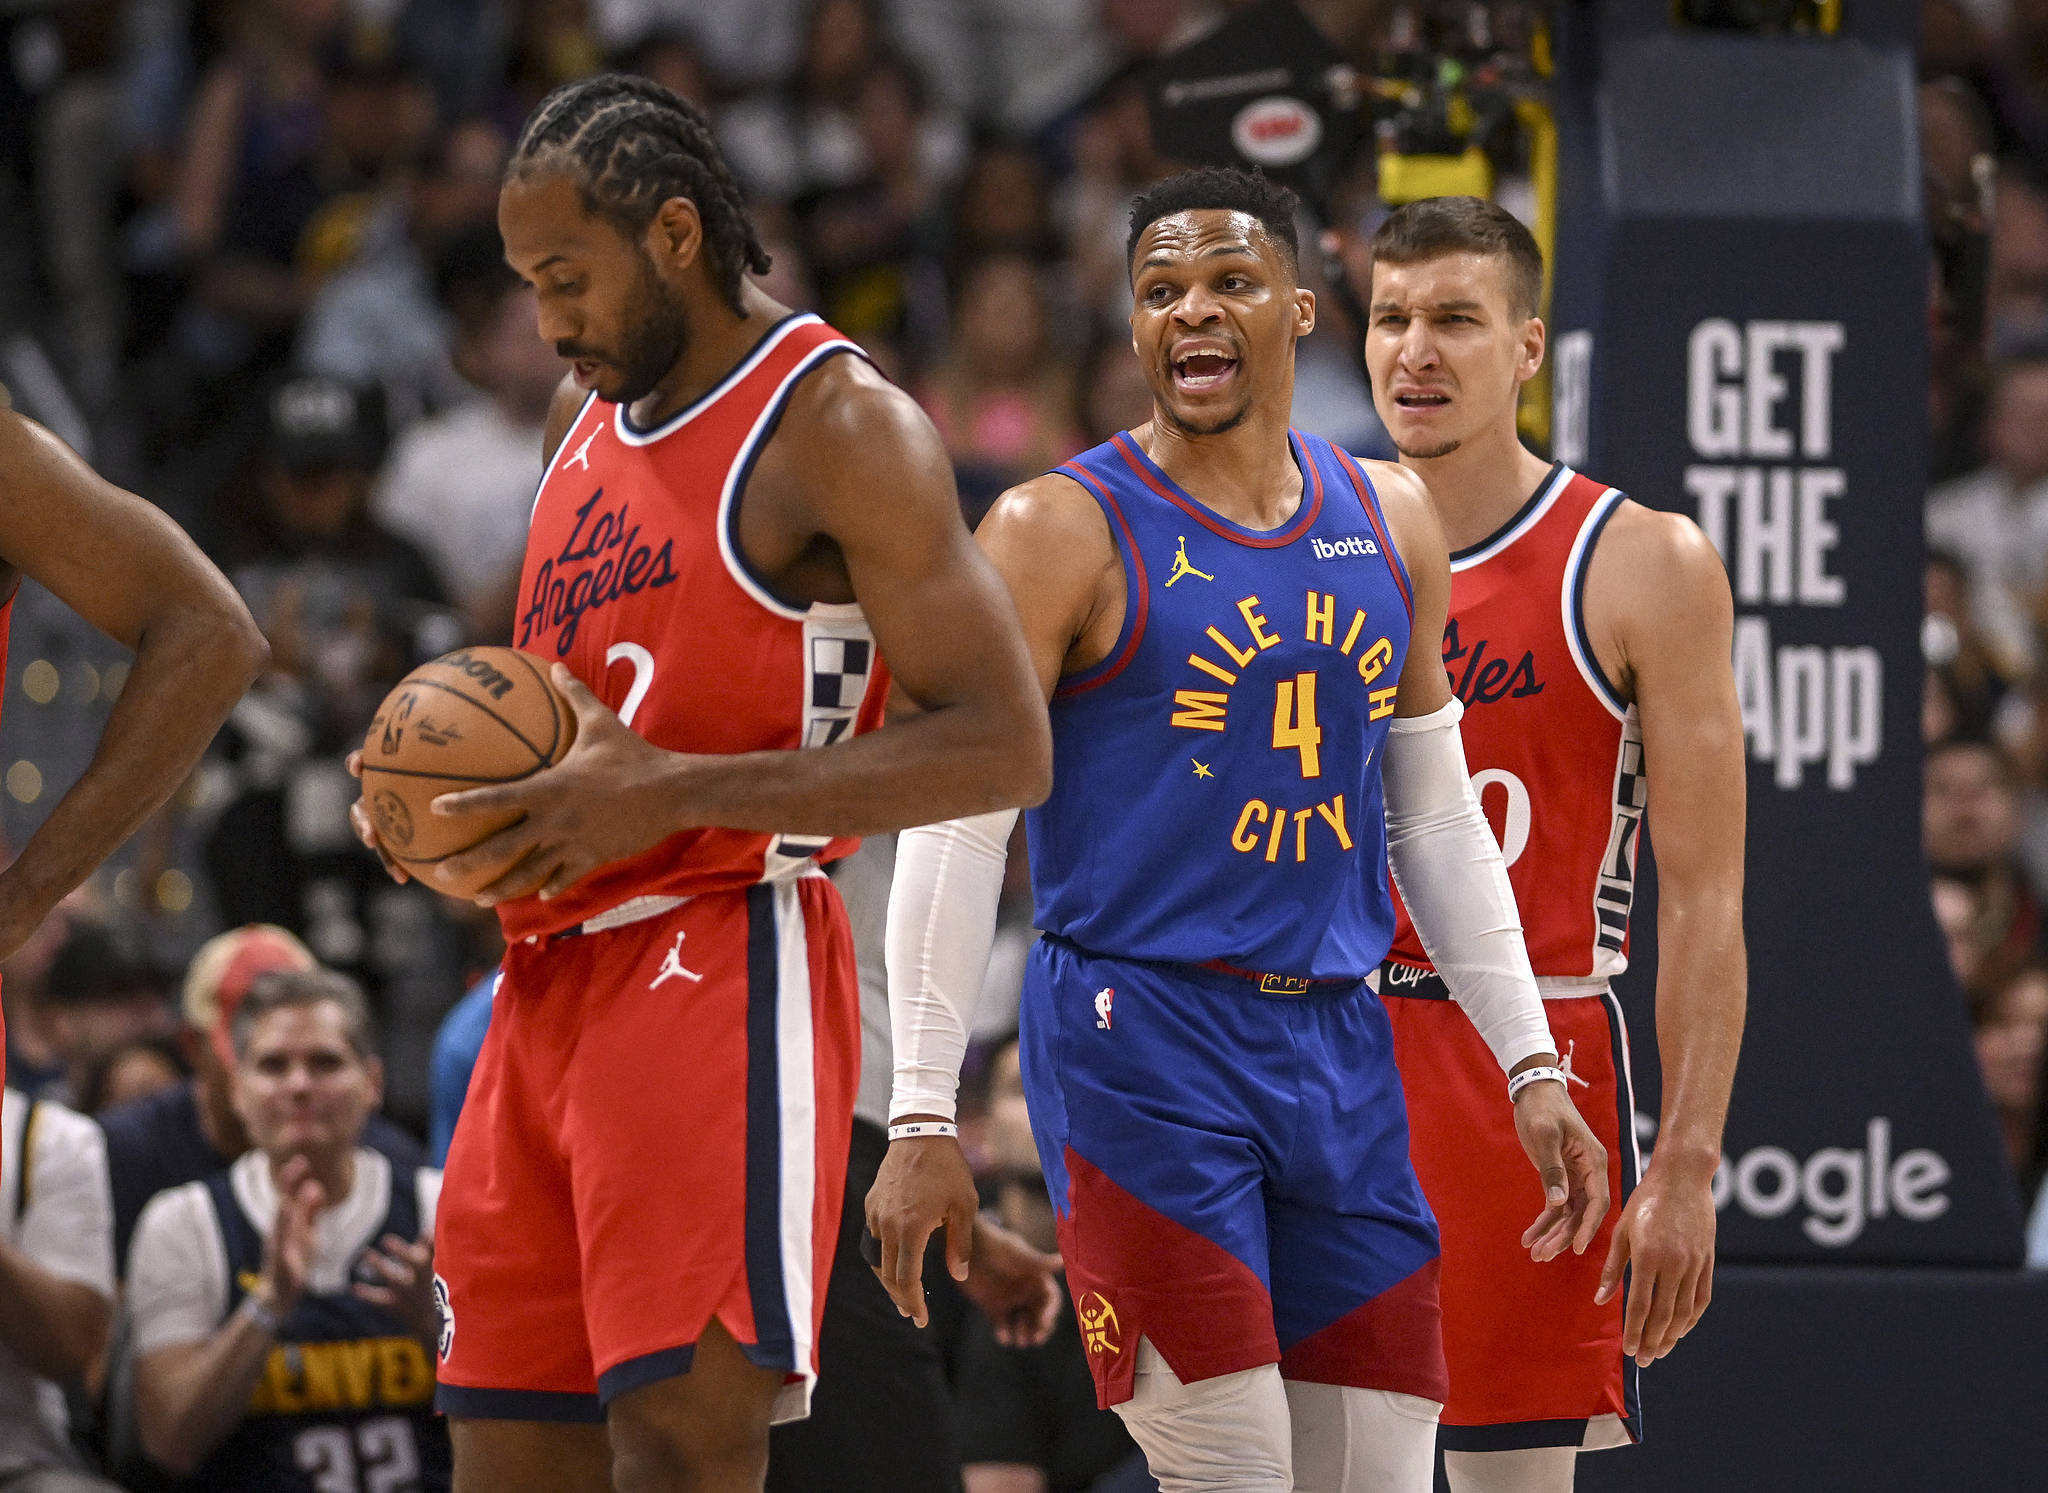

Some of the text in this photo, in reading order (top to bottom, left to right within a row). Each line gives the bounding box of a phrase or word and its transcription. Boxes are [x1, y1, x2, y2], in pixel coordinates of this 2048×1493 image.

[1687, 318, 1846, 457] GET
[519, 525, 680, 657] Angeles
[557, 487, 628, 566] Los
[1310, 536, 1379, 560] ibotta
[1684, 464, 1847, 606] THE
[1171, 590, 1399, 731] MILE HIGH
[1272, 670, 1322, 779] 4
[1732, 616, 1883, 790] App
[1231, 793, 1353, 863] CITY
